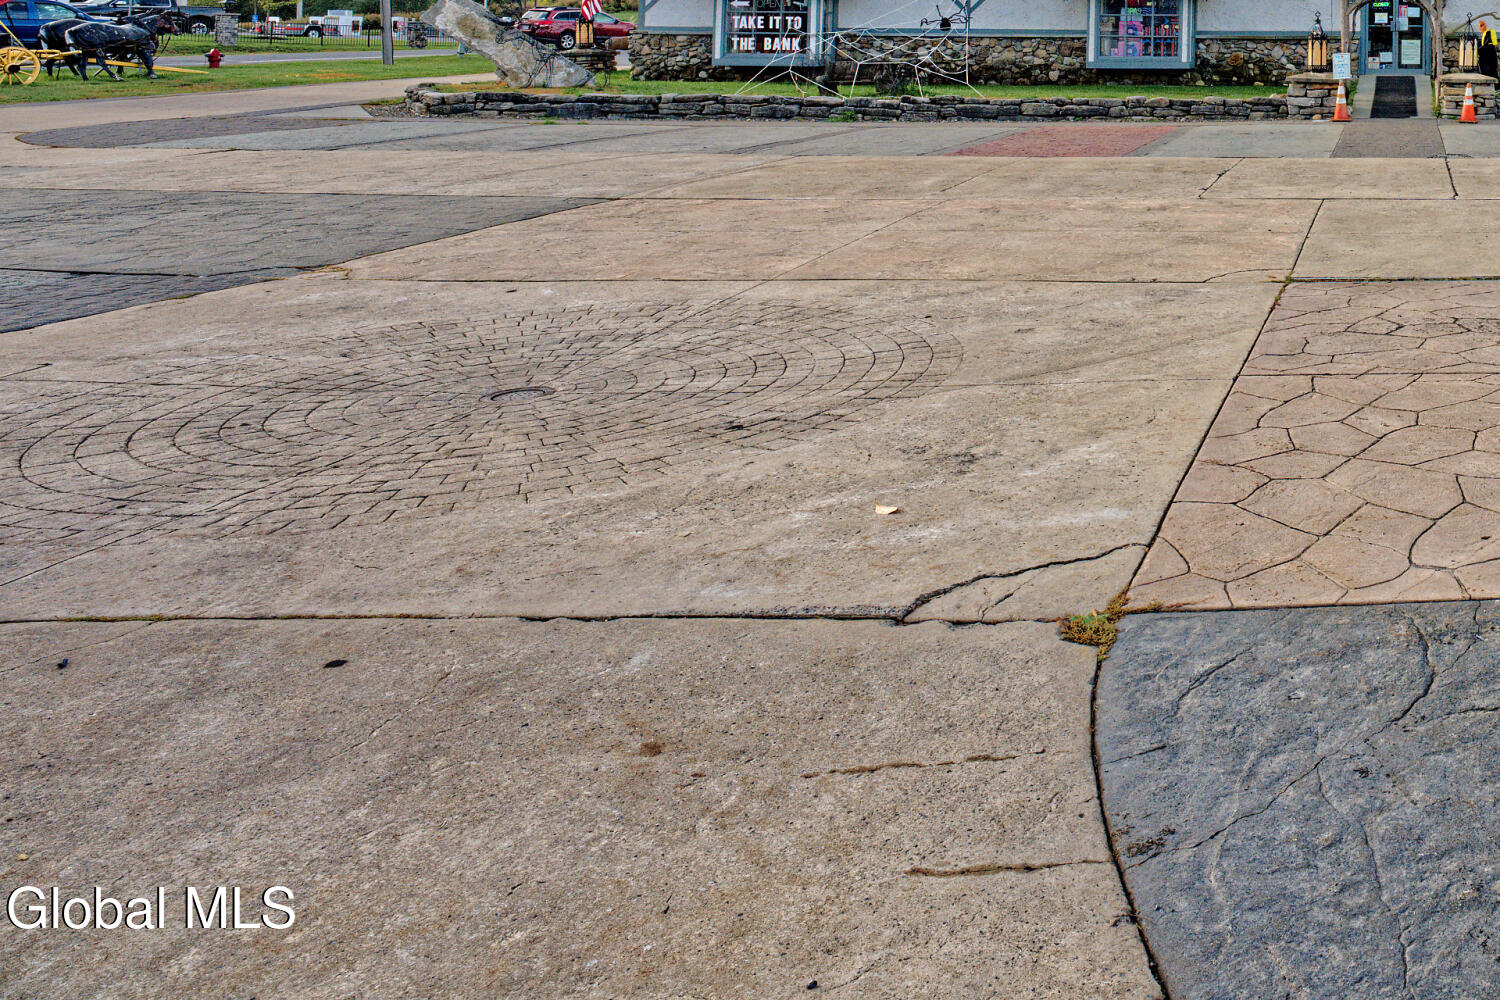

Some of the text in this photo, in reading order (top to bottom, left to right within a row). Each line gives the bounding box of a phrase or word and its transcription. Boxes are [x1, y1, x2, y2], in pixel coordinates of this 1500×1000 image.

[732, 16, 802, 29] TAKE IT TO
[731, 37, 800, 50] THE BANK
